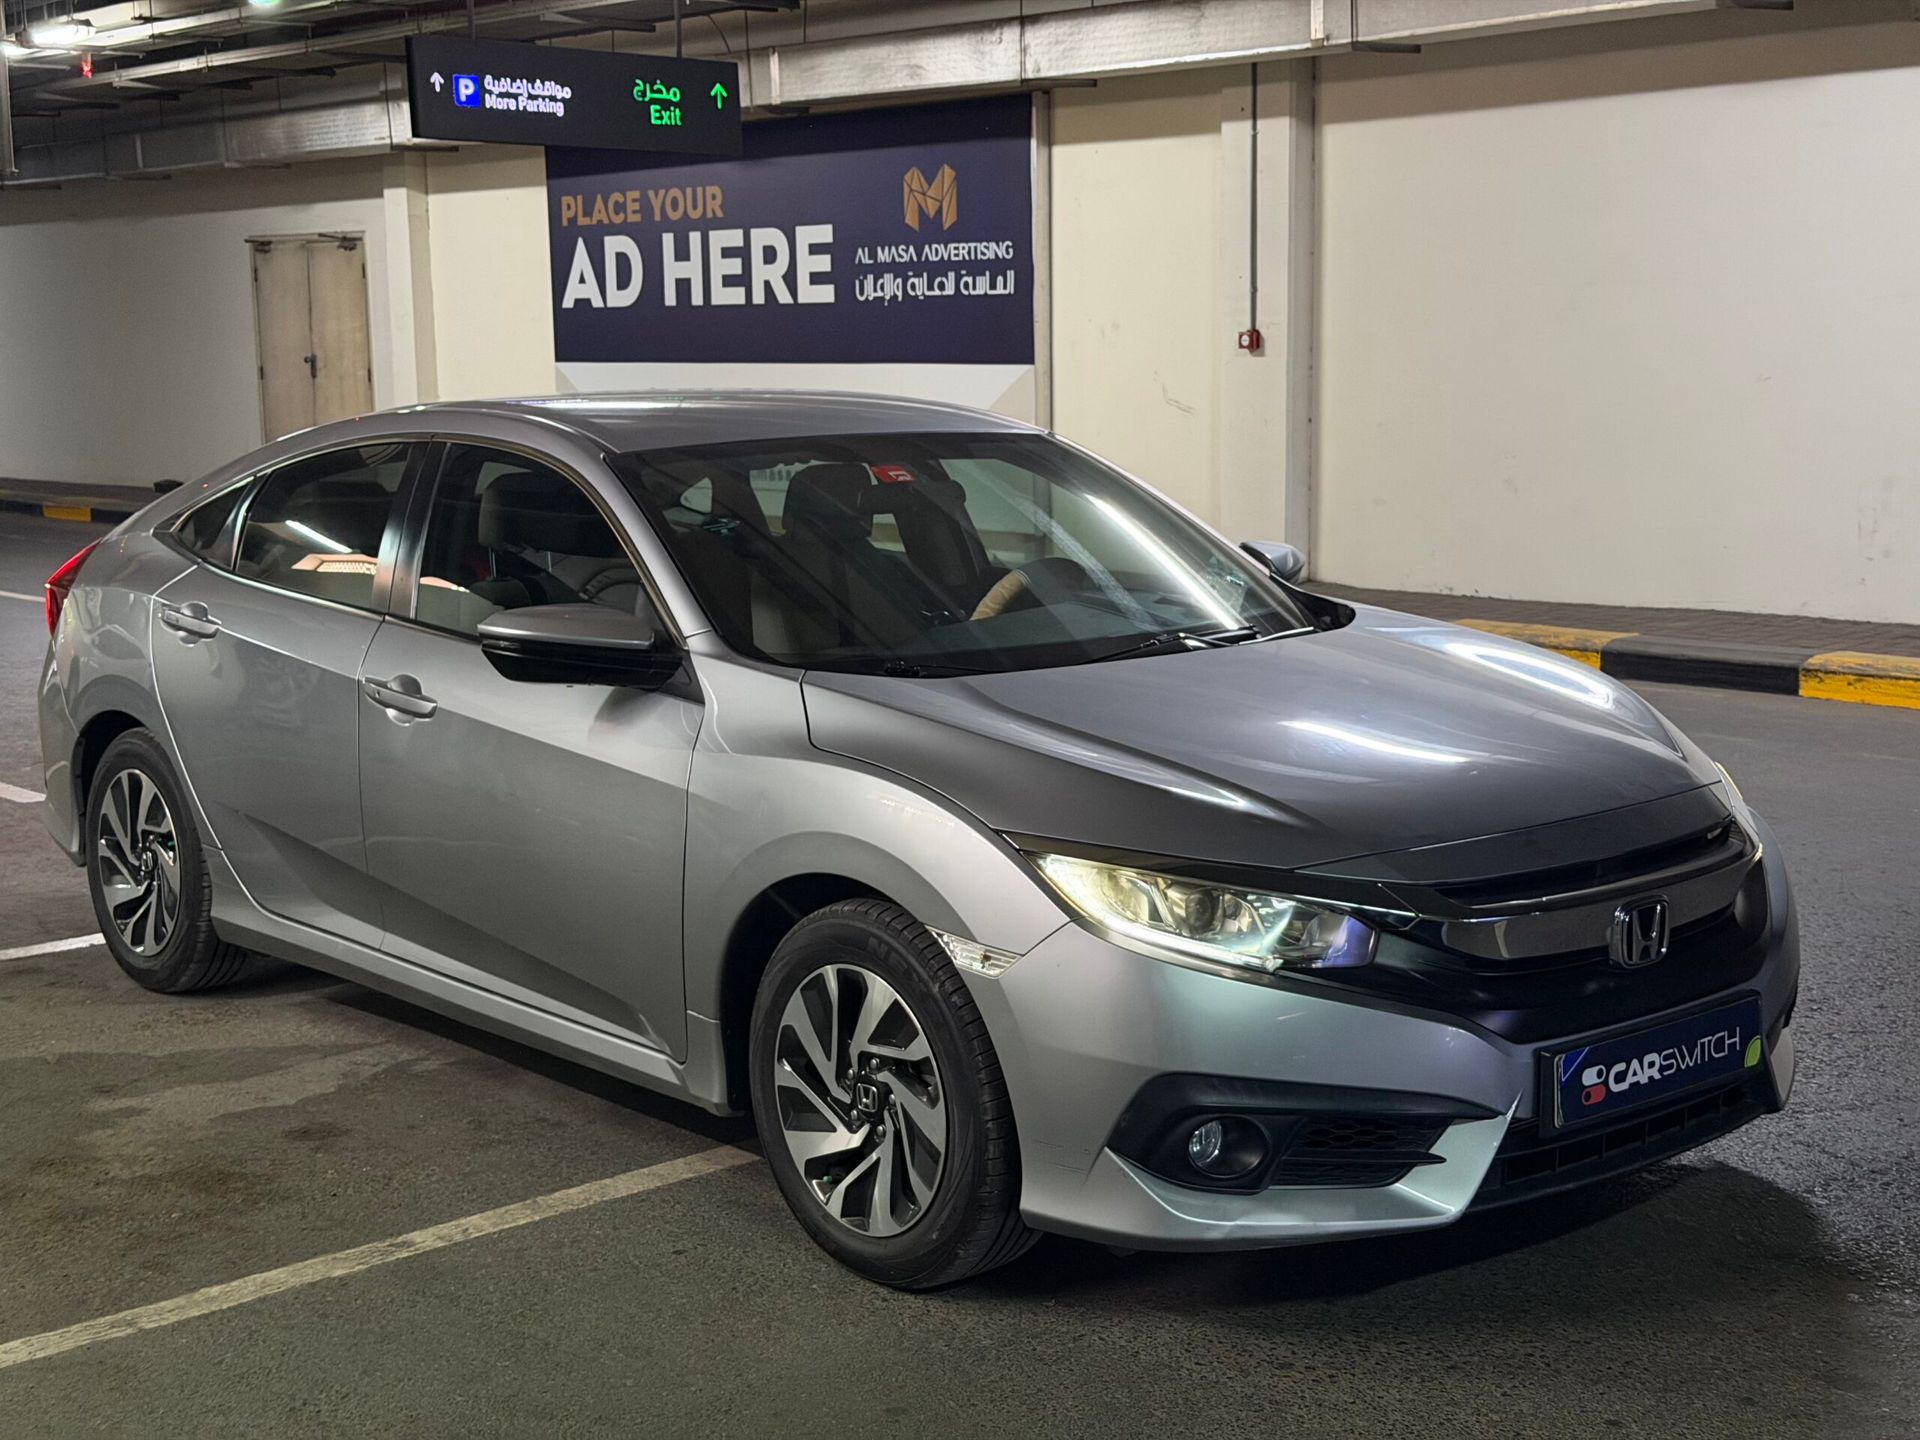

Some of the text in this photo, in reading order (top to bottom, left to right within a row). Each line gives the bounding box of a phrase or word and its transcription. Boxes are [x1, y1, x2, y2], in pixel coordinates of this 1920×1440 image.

[458, 78, 475, 102] P
[528, 79, 572, 99] مواقف
[633, 79, 681, 102] مخرج
[484, 93, 564, 117] More Parking
[650, 104, 682, 126] Exit
[560, 185, 724, 227] PLACE YOUR
[855, 241, 1014, 264] AL MASA ADVERTISING
[561, 224, 836, 309] AD HERE
[960, 270, 1014, 295] الماسة
[1608, 1026, 1741, 1093] CARSWITCH
